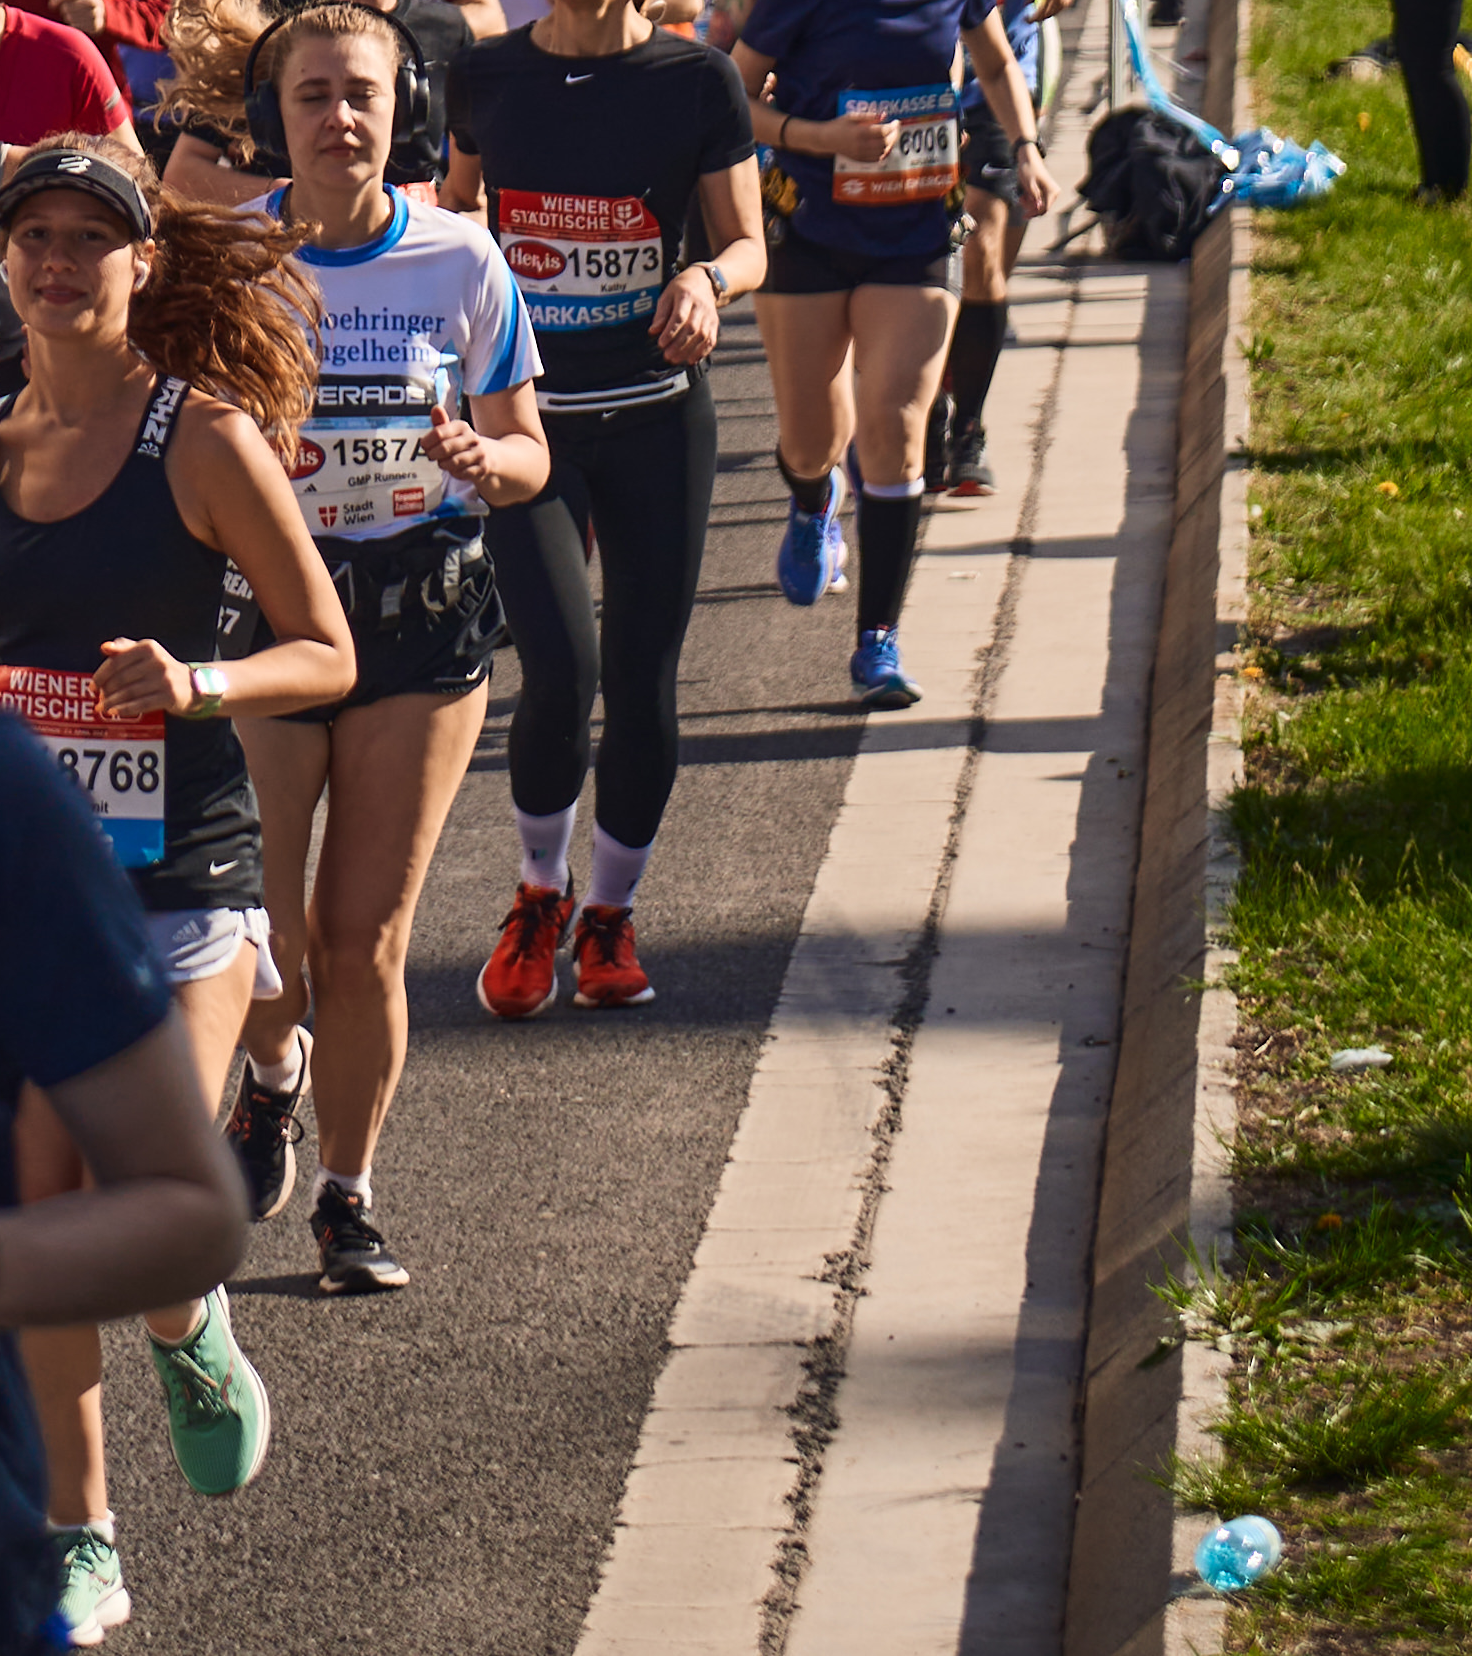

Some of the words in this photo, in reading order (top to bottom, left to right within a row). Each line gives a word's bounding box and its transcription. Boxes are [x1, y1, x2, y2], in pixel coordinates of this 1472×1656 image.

[541, 196, 610, 215] WIENER
[510, 209, 610, 230] STÄDTISCHE
[510, 246, 561, 273] Hervis
[568, 247, 657, 278] 15873
[342, 499, 375, 514] Stadt
[342, 512, 376, 526] Wien
[10, 668, 95, 698] WIENER
